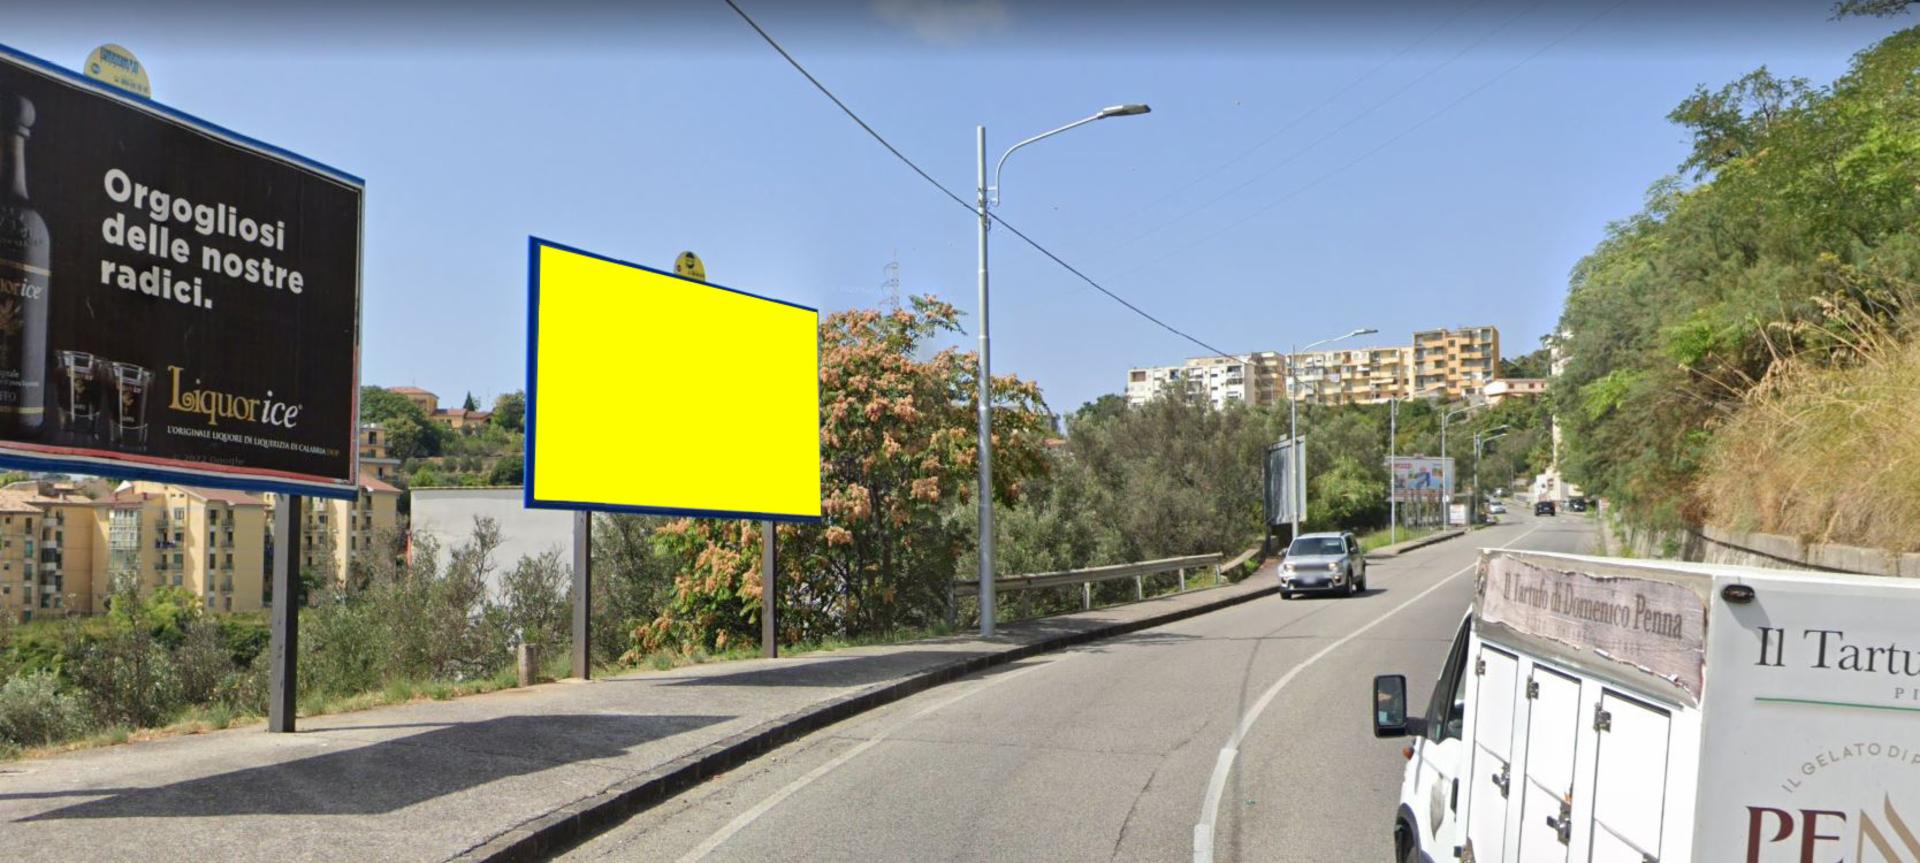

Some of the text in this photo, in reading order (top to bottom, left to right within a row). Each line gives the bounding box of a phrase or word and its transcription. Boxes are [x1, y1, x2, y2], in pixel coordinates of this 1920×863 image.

[104, 168, 285, 250] Orgogliosi
[102, 212, 305, 295] delle nostre
[101, 259, 213, 310] radici.
[168, 365, 298, 428] Liquorice
[167, 425, 211, 439] L'ORIGINALE
[212, 431, 243, 443] LIQUORE
[244, 436, 253, 444] DI
[1503, 572, 1510, 600] Il
[1512, 573, 1549, 610] Tartufo
[1550, 583, 1562, 613] di
[1563, 583, 1631, 629] Domenico
[1633, 593, 1683, 640] Penna
[1754, 626, 1786, 667] Il
[1781, 778, 1802, 794] IL
[1801, 742, 1881, 776] GELATO
[1887, 745, 1908, 762] DI
